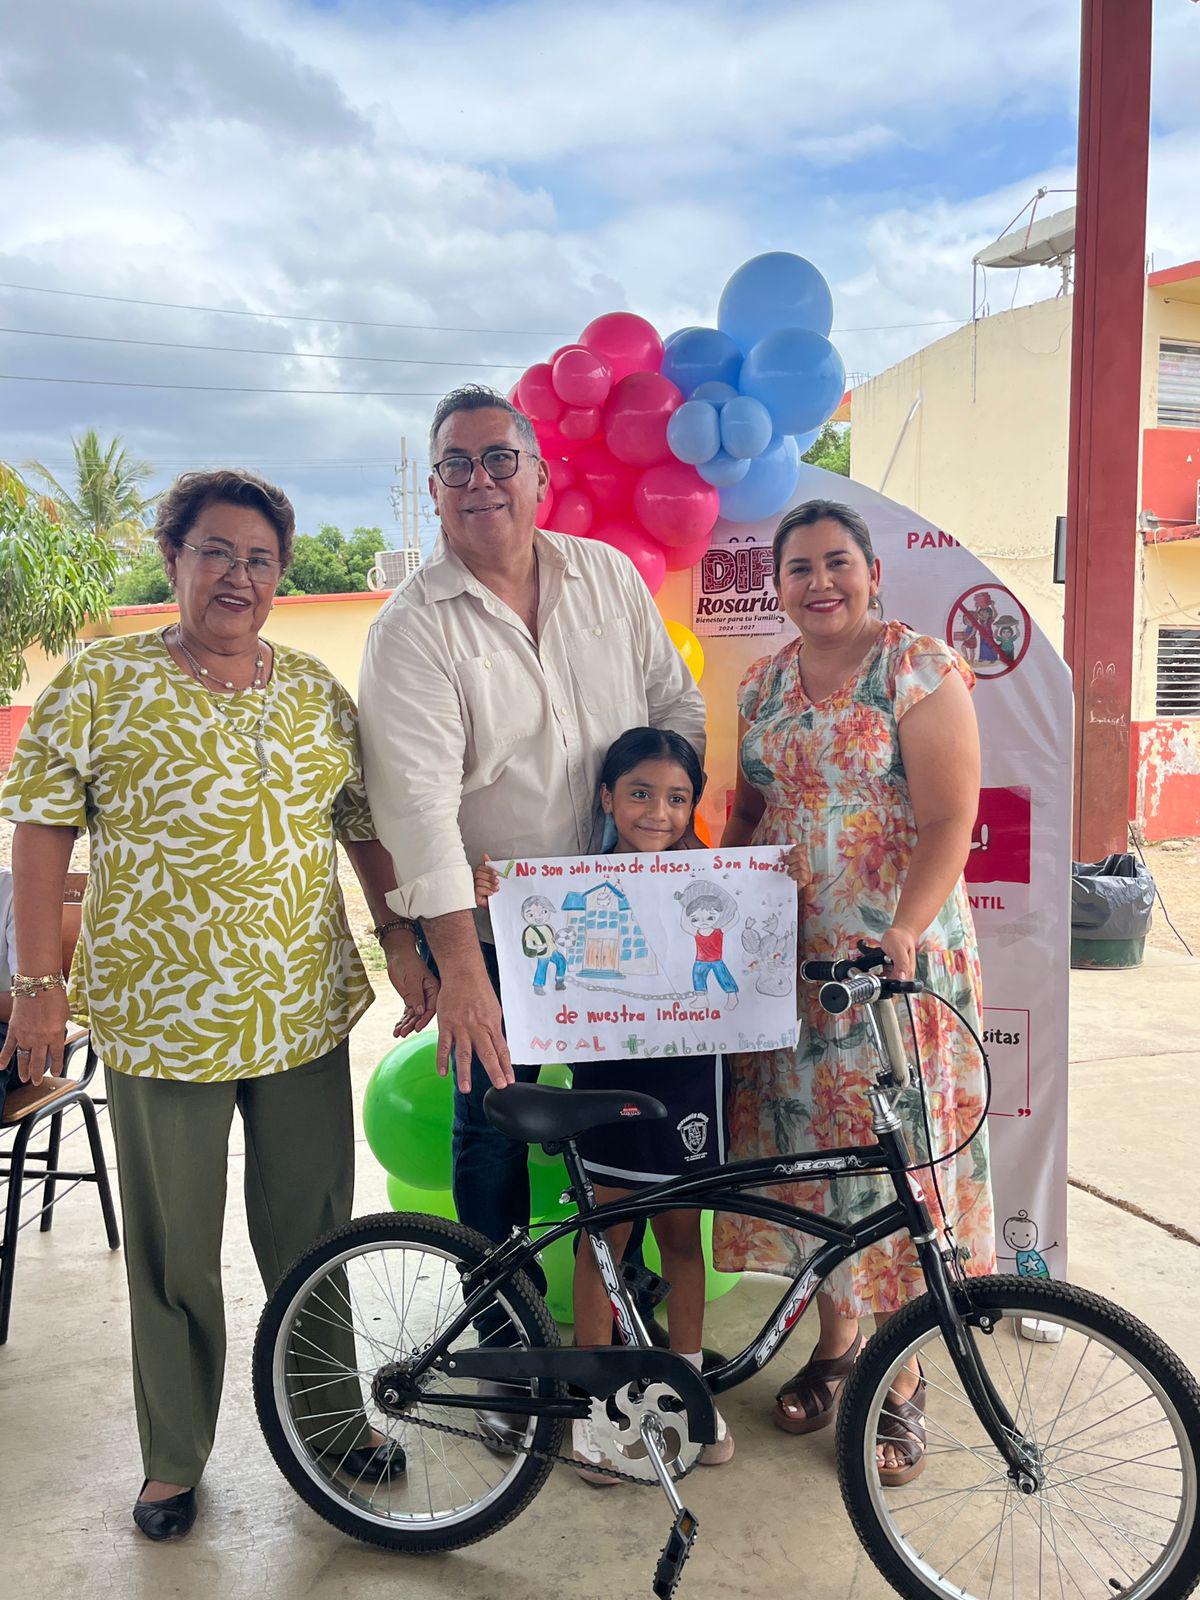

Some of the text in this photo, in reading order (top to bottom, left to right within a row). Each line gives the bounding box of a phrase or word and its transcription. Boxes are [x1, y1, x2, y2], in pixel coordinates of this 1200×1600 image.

[907, 531, 961, 549] PAN
[702, 546, 774, 594] DIF
[697, 591, 779, 615] Rosario
[696, 616, 726, 624] Bienestar
[516, 861, 537, 877] No
[541, 864, 563, 877] son
[569, 861, 590, 875] solo
[628, 857, 644, 874] de
[713, 856, 742, 870] Son
[968, 896, 1005, 910] NTIL
[555, 1002, 721, 1024] de nuestra infancia
[530, 1035, 568, 1051] NO
[575, 1036, 606, 1052] AL
[982, 1029, 1020, 1045] sitas
